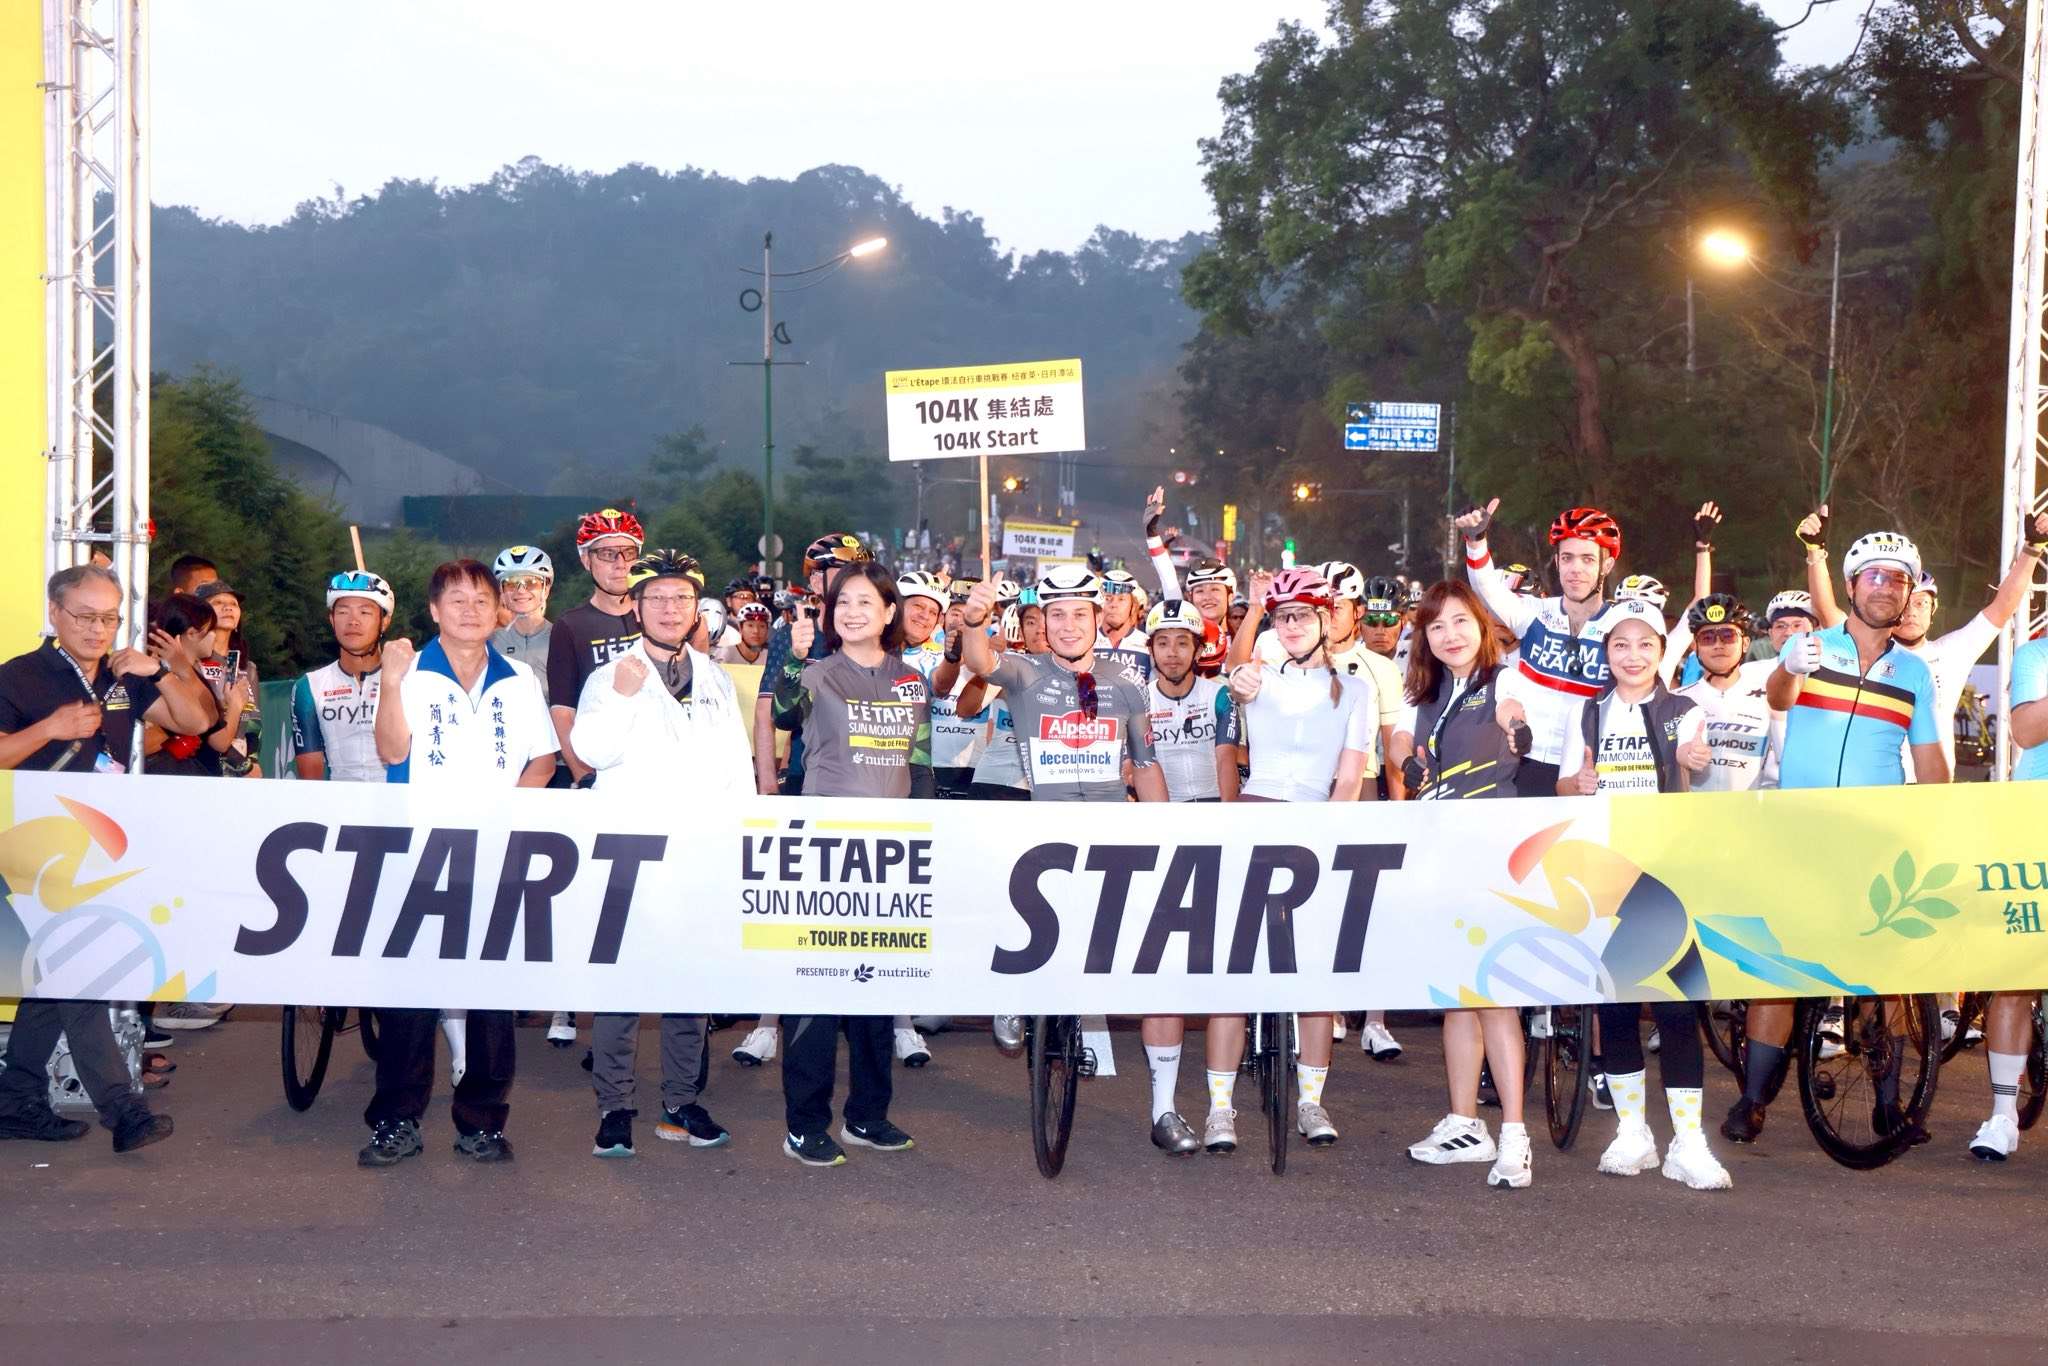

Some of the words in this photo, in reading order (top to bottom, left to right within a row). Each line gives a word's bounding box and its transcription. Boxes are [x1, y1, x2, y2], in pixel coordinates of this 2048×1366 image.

[915, 397, 979, 424] 104K
[987, 396, 1054, 420] 集結處
[934, 431, 981, 451] 104K
[987, 428, 1039, 447] Start
[1014, 534, 1037, 545] 104K
[1878, 544, 1900, 553] 1267
[902, 684, 924, 697] 2580
[847, 701, 914, 725] L'ÉTAPE
[491, 696, 507, 769] 南投縣政府
[848, 723, 867, 734] SUN
[868, 724, 896, 736] MOON
[936, 726, 976, 735] CADEX
[1048, 718, 1110, 736] Alpecin
[1040, 750, 1112, 766] deceuninck
[1708, 758, 1748, 769] ADEX
[742, 819, 933, 885] L'ÉTAPE
[234, 822, 668, 965] START
[742, 889, 789, 915] SUN
[796, 890, 870, 917] MOON
[876, 892, 933, 918] LAKE
[991, 842, 1407, 975] START
[798, 936, 808, 946] BY
[809, 930, 848, 947] TOUR
[850, 931, 869, 948] DE
[871, 932, 928, 949] FRANCE
[796, 967, 839, 977] PRESENTED
[839, 968, 849, 977] BY
[878, 966, 931, 978] nutrilite
